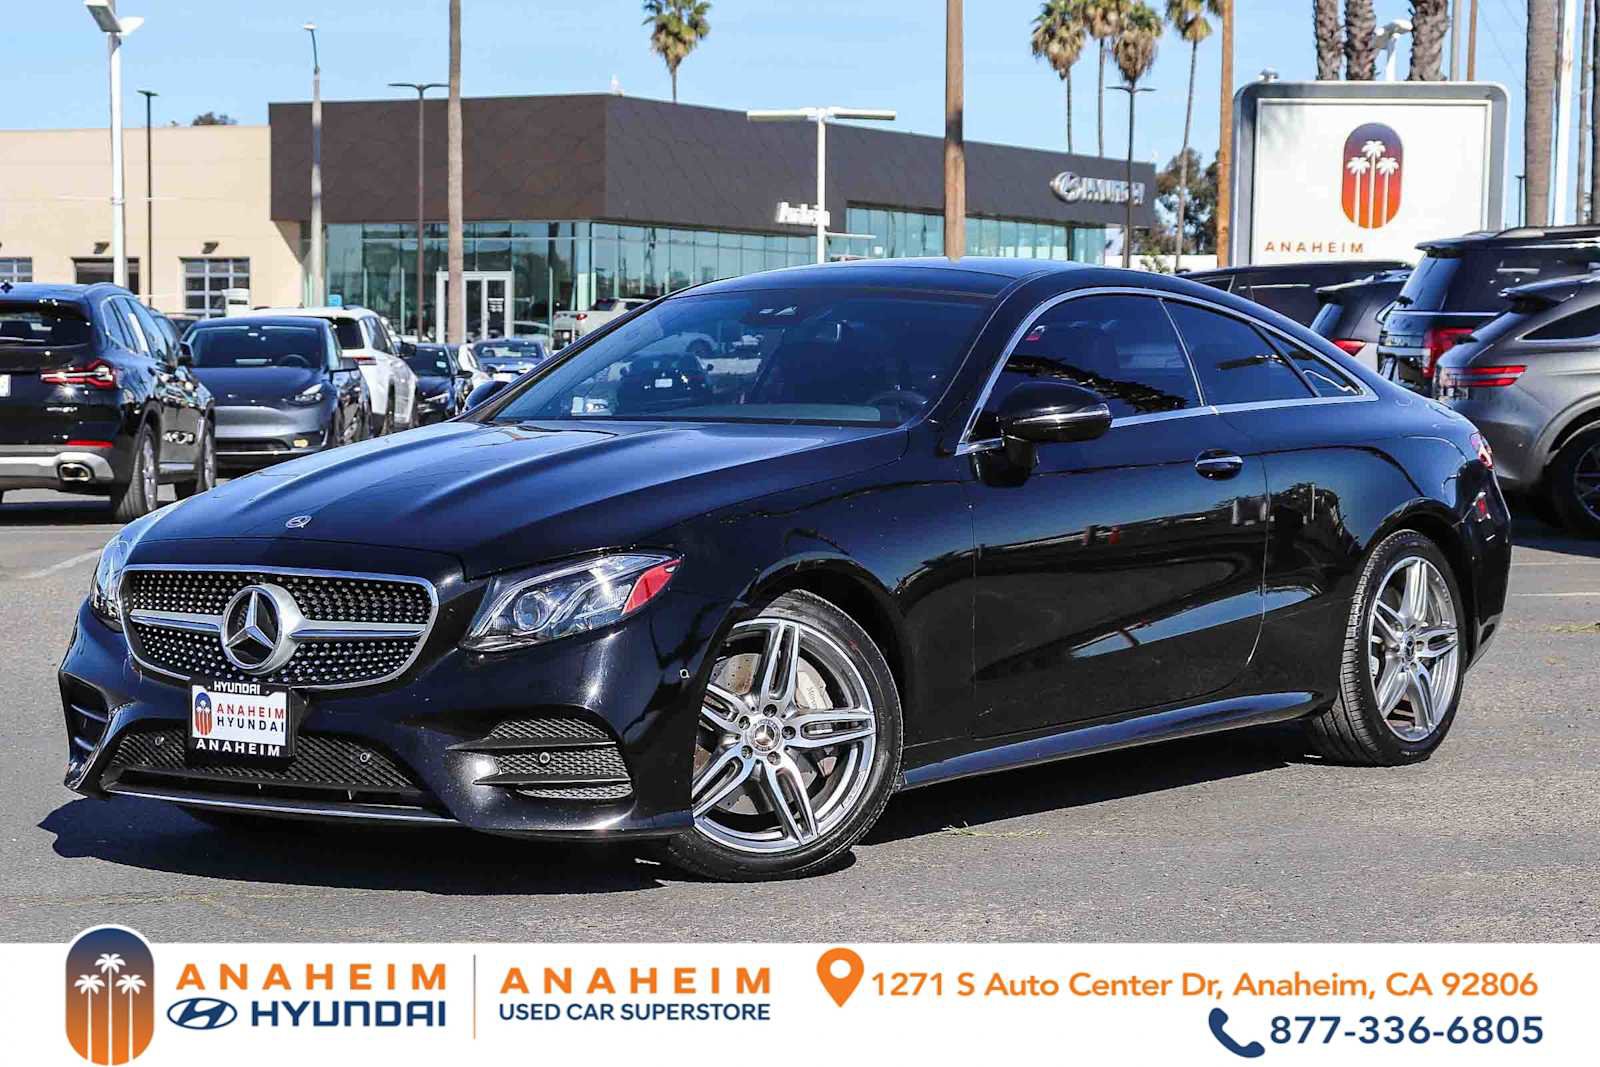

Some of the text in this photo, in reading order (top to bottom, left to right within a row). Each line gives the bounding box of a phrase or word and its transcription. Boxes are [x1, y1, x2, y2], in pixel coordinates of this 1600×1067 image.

[1265, 241, 1364, 254] ANAHEIM
[213, 681, 261, 696] HYUNDAI
[216, 703, 285, 719] ANAHEIM
[216, 716, 285, 733] HYUNDAI
[196, 738, 281, 757] ANAHEIM
